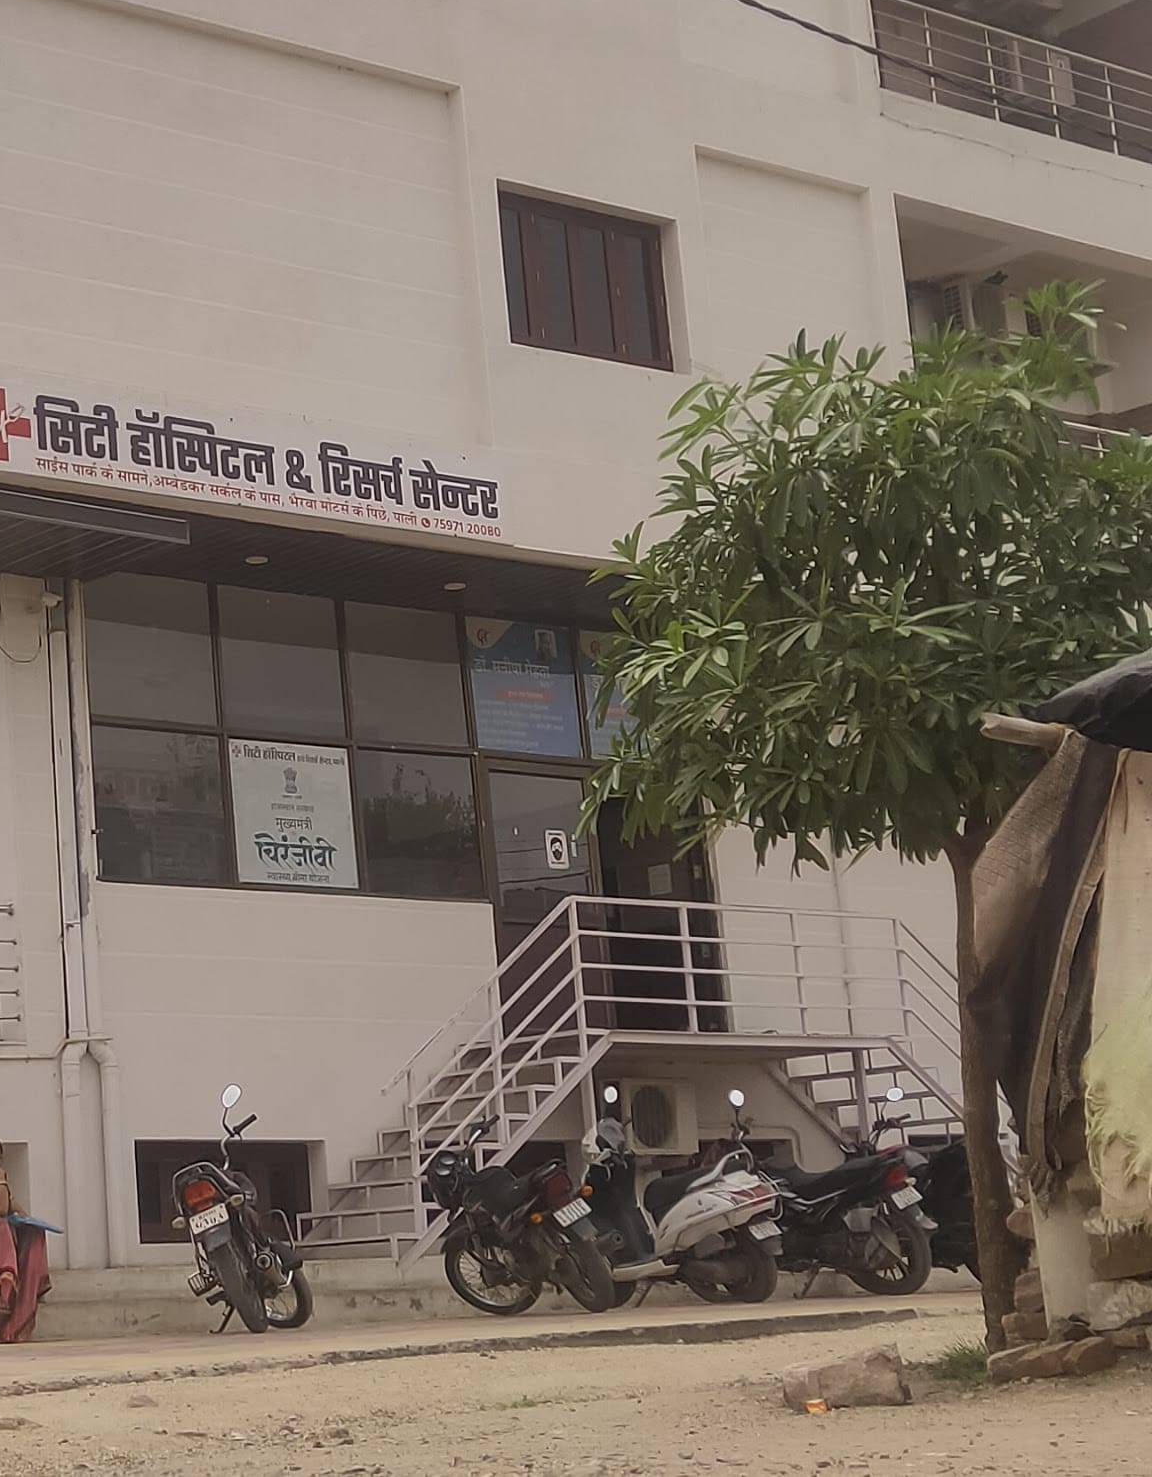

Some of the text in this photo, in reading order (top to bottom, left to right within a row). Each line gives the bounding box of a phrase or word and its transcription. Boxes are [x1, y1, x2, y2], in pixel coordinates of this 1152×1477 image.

[33, 394, 498, 519] सिटी हॉस्पिटल & रिसर्च सेन्टर
[101, 464, 114, 481] के
[433, 518, 464, 532] 75971
[467, 522, 502, 537] 20080
[254, 832, 337, 870] चिरंजीवी
